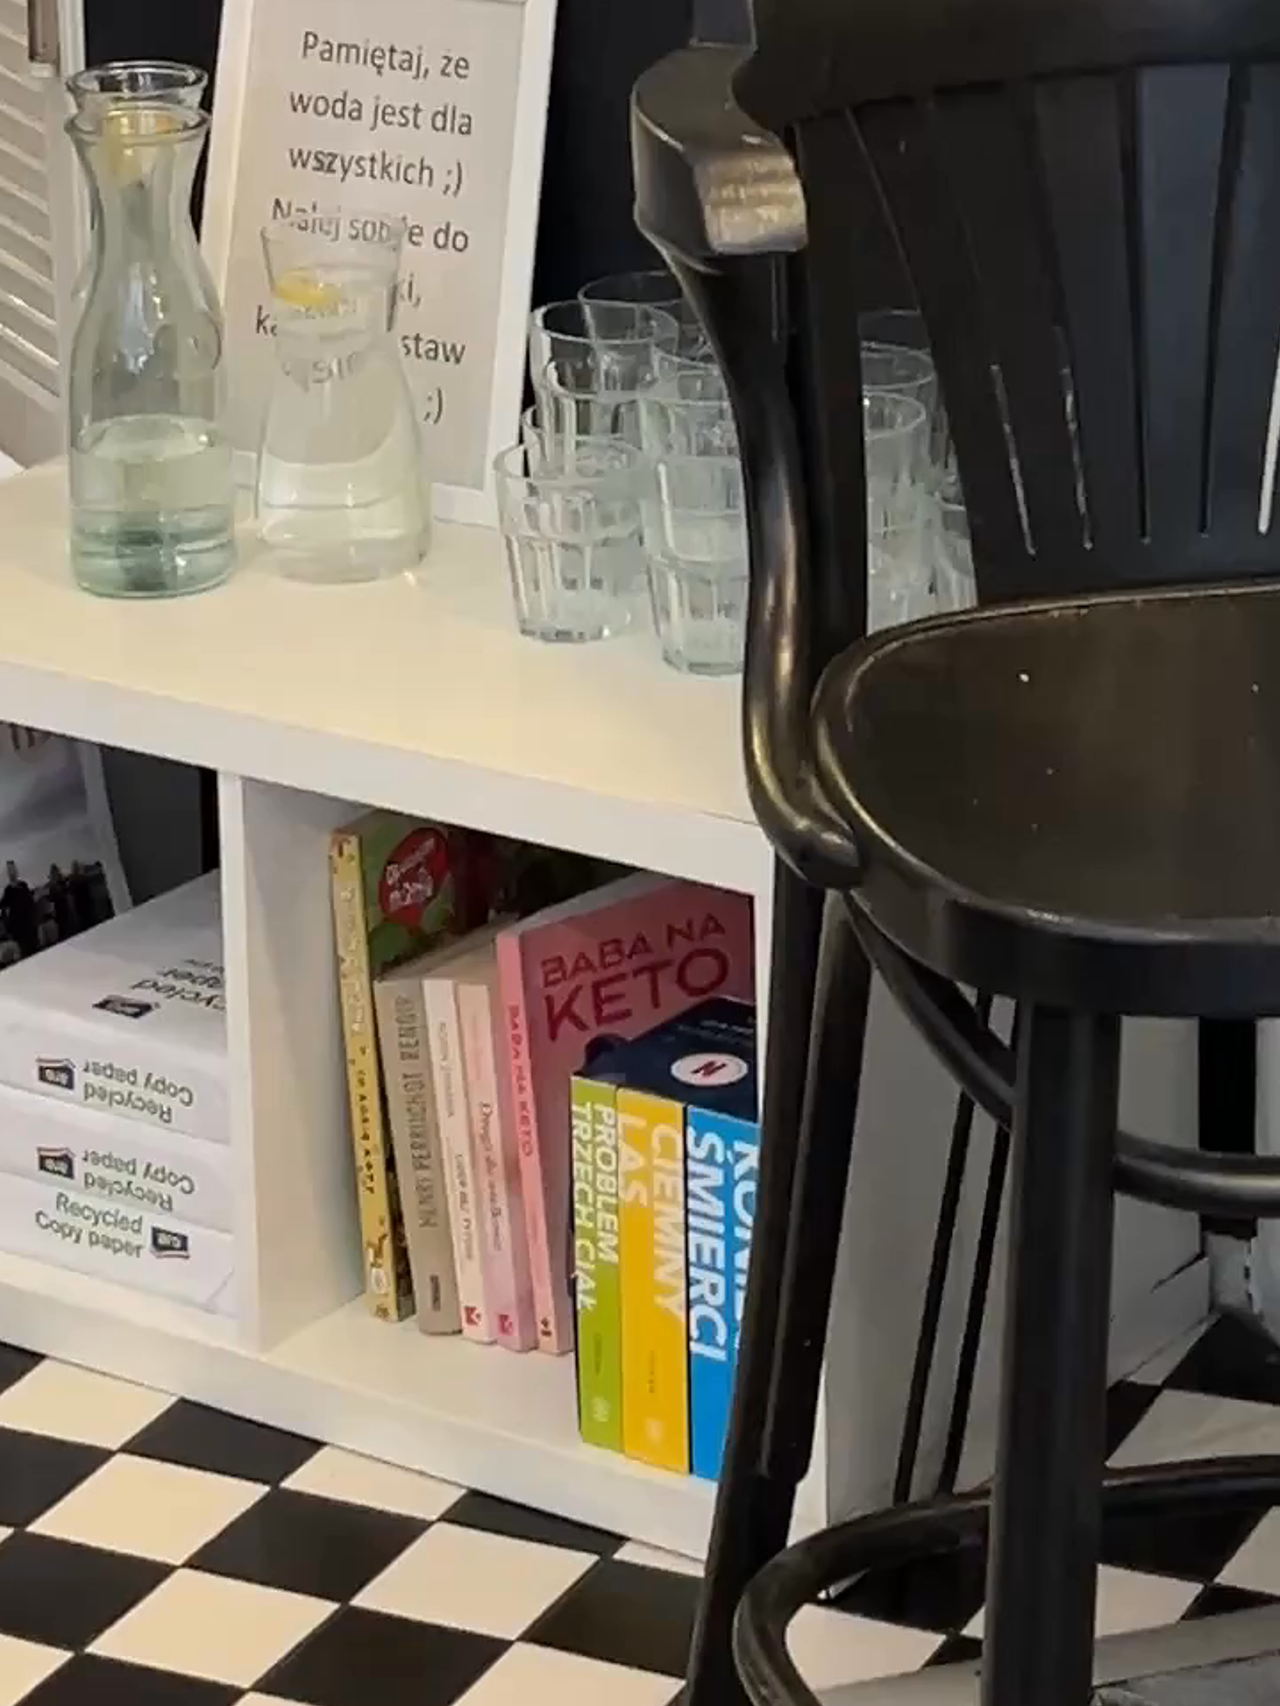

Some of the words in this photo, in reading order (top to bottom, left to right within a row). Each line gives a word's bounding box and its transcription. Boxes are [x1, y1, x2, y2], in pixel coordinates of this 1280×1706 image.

[301, 29, 430, 81] Pamiętaj,
[289, 89, 365, 123] woda
[369, 94, 423, 132] jest
[430, 102, 473, 136] dla
[288, 147, 435, 189] wszystkich
[442, 159, 464, 199] ;)
[432, 219, 470, 254] do
[539, 930, 655, 989] BABA
[665, 911, 727, 949] NA
[543, 947, 731, 1043] KETO
[81, 1058, 139, 1086] paper
[142, 1071, 195, 1108] Copy
[82, 1081, 173, 1124] Recycled
[81, 1148, 138, 1176] paper
[142, 1161, 197, 1196] Copy
[571, 1100, 594, 1229] TRZECH
[594, 1102, 620, 1264] PROBLEM
[617, 1111, 649, 1208] LAS
[55, 1191, 144, 1236] Recycled
[83, 1171, 174, 1213] Recycled
[33, 1209, 85, 1245] Copy
[88, 1230, 145, 1259] paper
[650, 1123, 686, 1323] CIEMNY
[686, 1126, 734, 1364] ŚMIERCI
